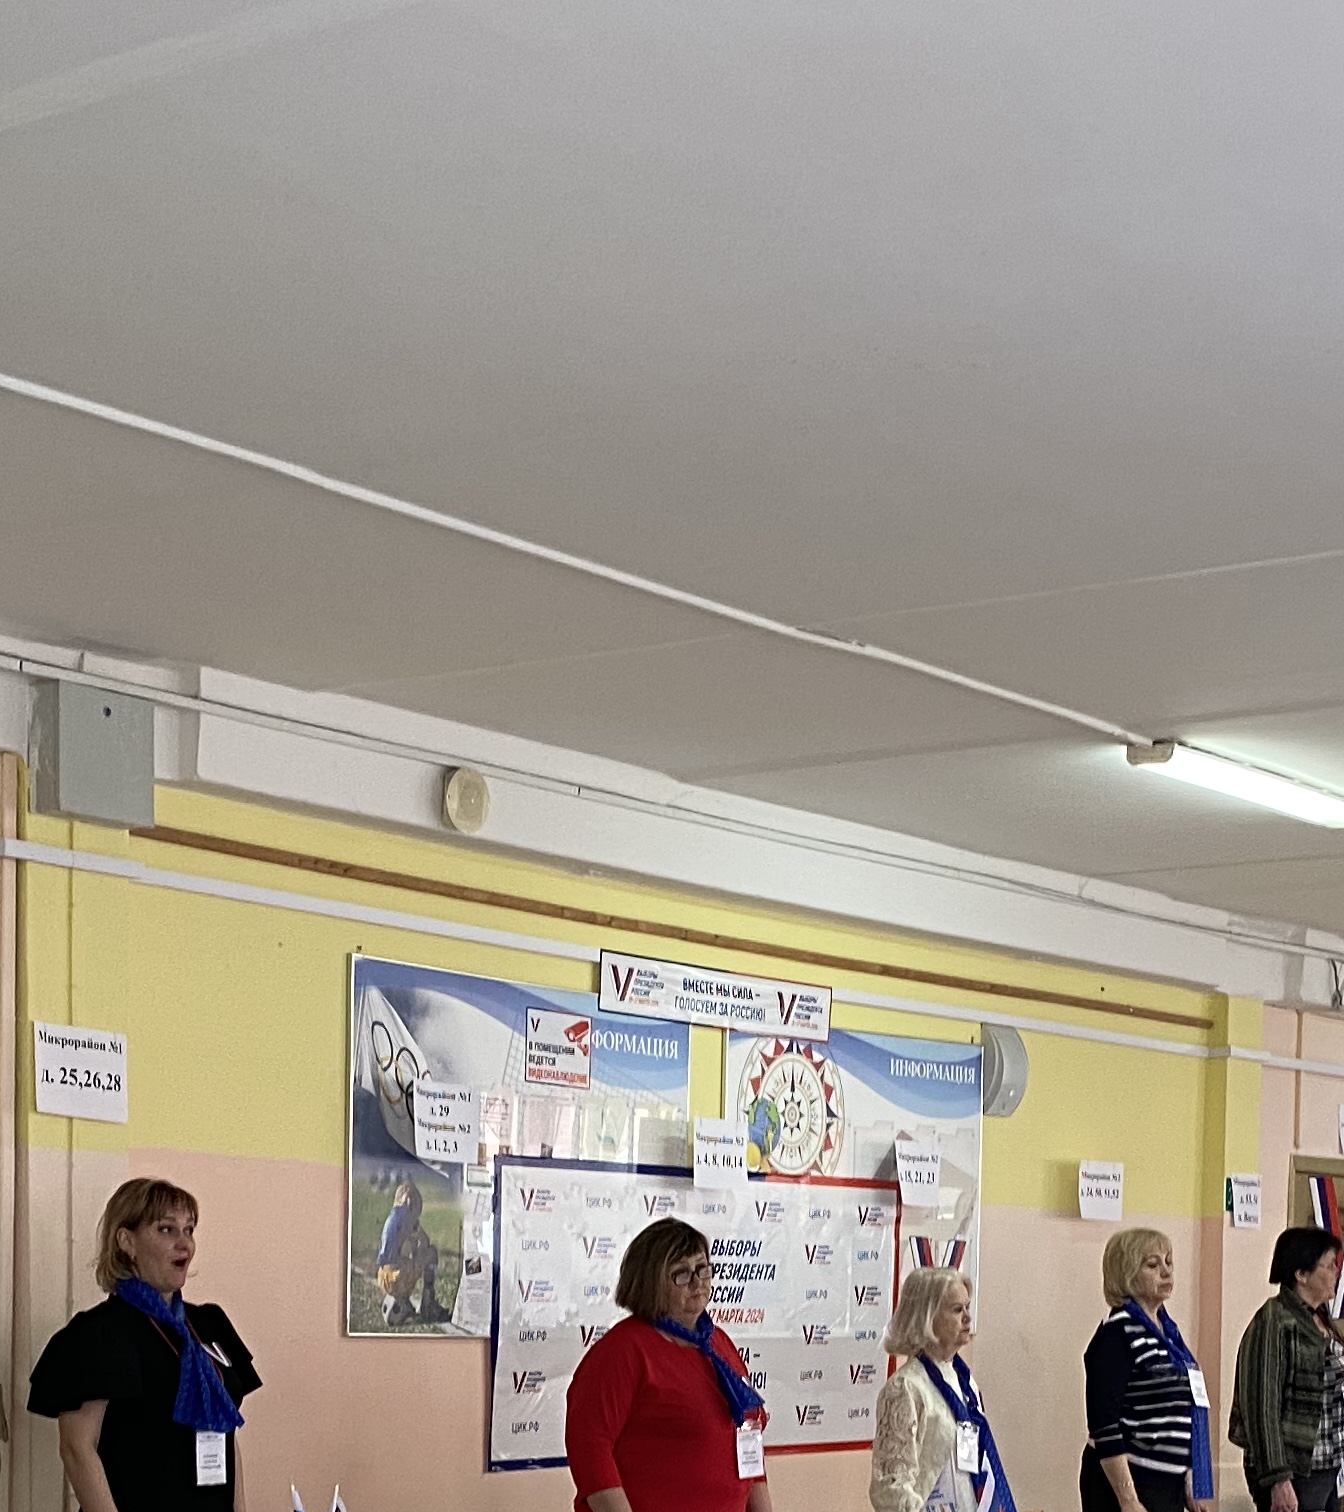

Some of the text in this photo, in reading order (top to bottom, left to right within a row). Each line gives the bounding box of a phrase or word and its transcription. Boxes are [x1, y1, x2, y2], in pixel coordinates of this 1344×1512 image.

[682, 977, 714, 997] ВМЕСТЕ
[715, 982, 731, 998] МЫ
[732, 985, 754, 1001] СИЛА
[674, 995, 718, 1016] ГОЛОСУЕМ
[718, 1001, 730, 1016] ЗА
[730, 1003, 767, 1023] РОССИЮ!
[38, 1030, 106, 1052] Микрорайон
[591, 1028, 679, 1060] ФОРМАЦИЯ
[41, 1068, 55, 1084] д.
[889, 1058, 976, 1085] ИНФОРМАЦИЯ
[439, 1104, 450, 1117] 29
[710, 1238, 763, 1258] ВЫБОРЫ
[710, 1262, 776, 1283] РЕЗИДЕНТА
[715, 1308, 744, 1324] МАРТА
[744, 1308, 765, 1324] 2024
[511, 1420, 540, 1435] ЦИК.РФ
